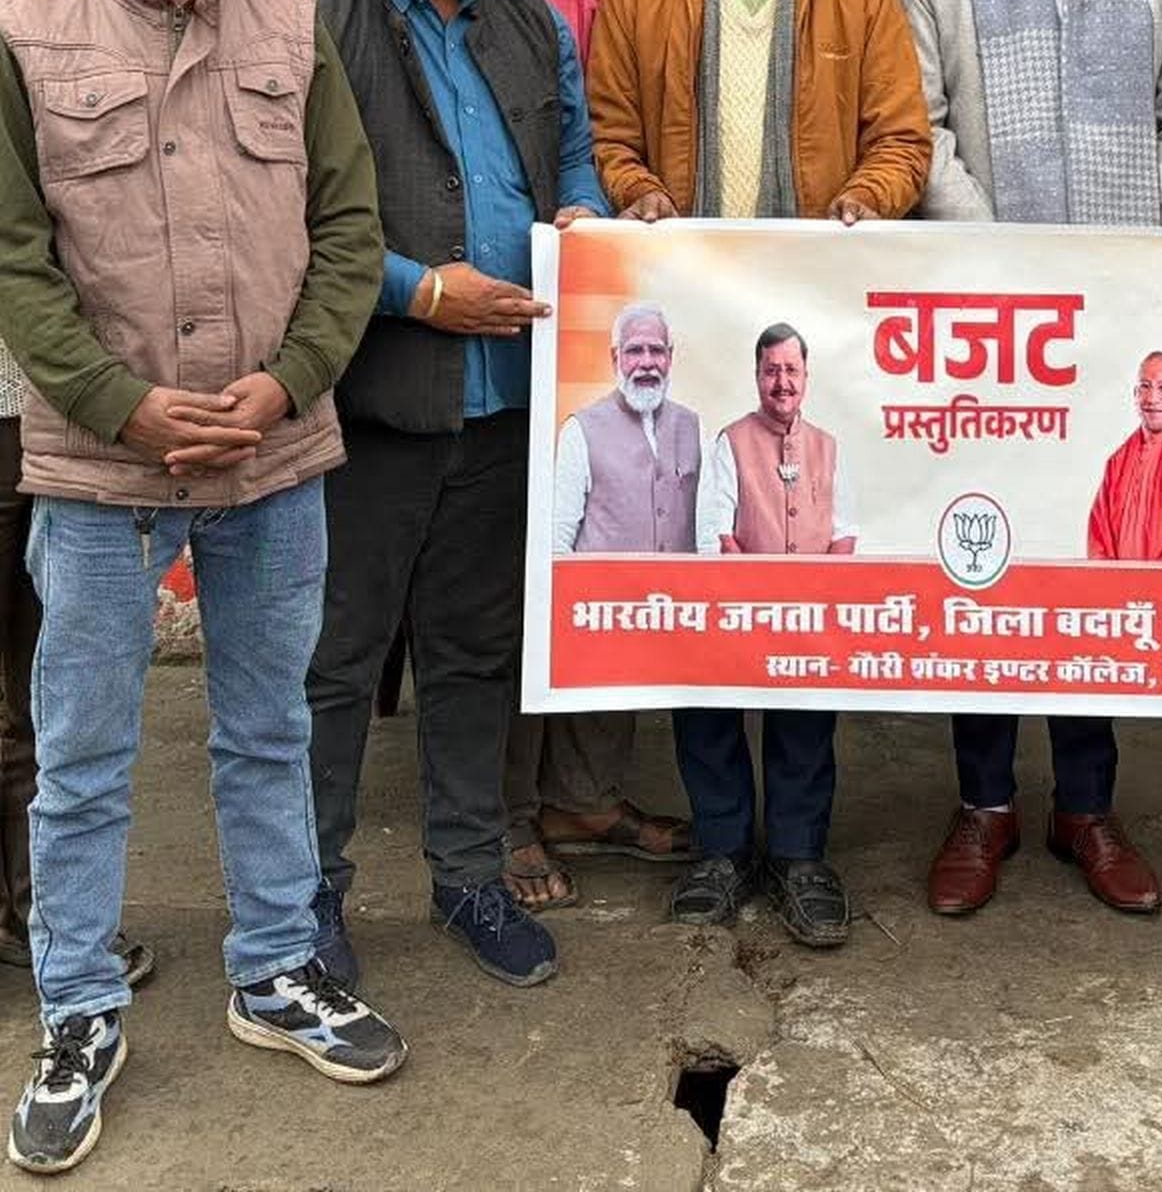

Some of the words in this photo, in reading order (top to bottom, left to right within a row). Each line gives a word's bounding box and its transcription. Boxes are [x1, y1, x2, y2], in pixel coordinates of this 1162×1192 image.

[866, 290, 1085, 387] बजट
[881, 393, 1070, 455] प्रस्तुतिकरण
[572, 593, 709, 633] भारतीय
[718, 602, 828, 633] जनता
[836, 593, 930, 642] पार्टी,
[944, 595, 1047, 638] जिला
[1055, 600, 1160, 651] बदायूँ
[766, 654, 842, 679] स्थान-
[848, 651, 904, 680] गौरी
[911, 654, 977, 682] शंकर
[983, 657, 1049, 686] इण्टर
[1056, 654, 1158, 690] कॉलेज,
